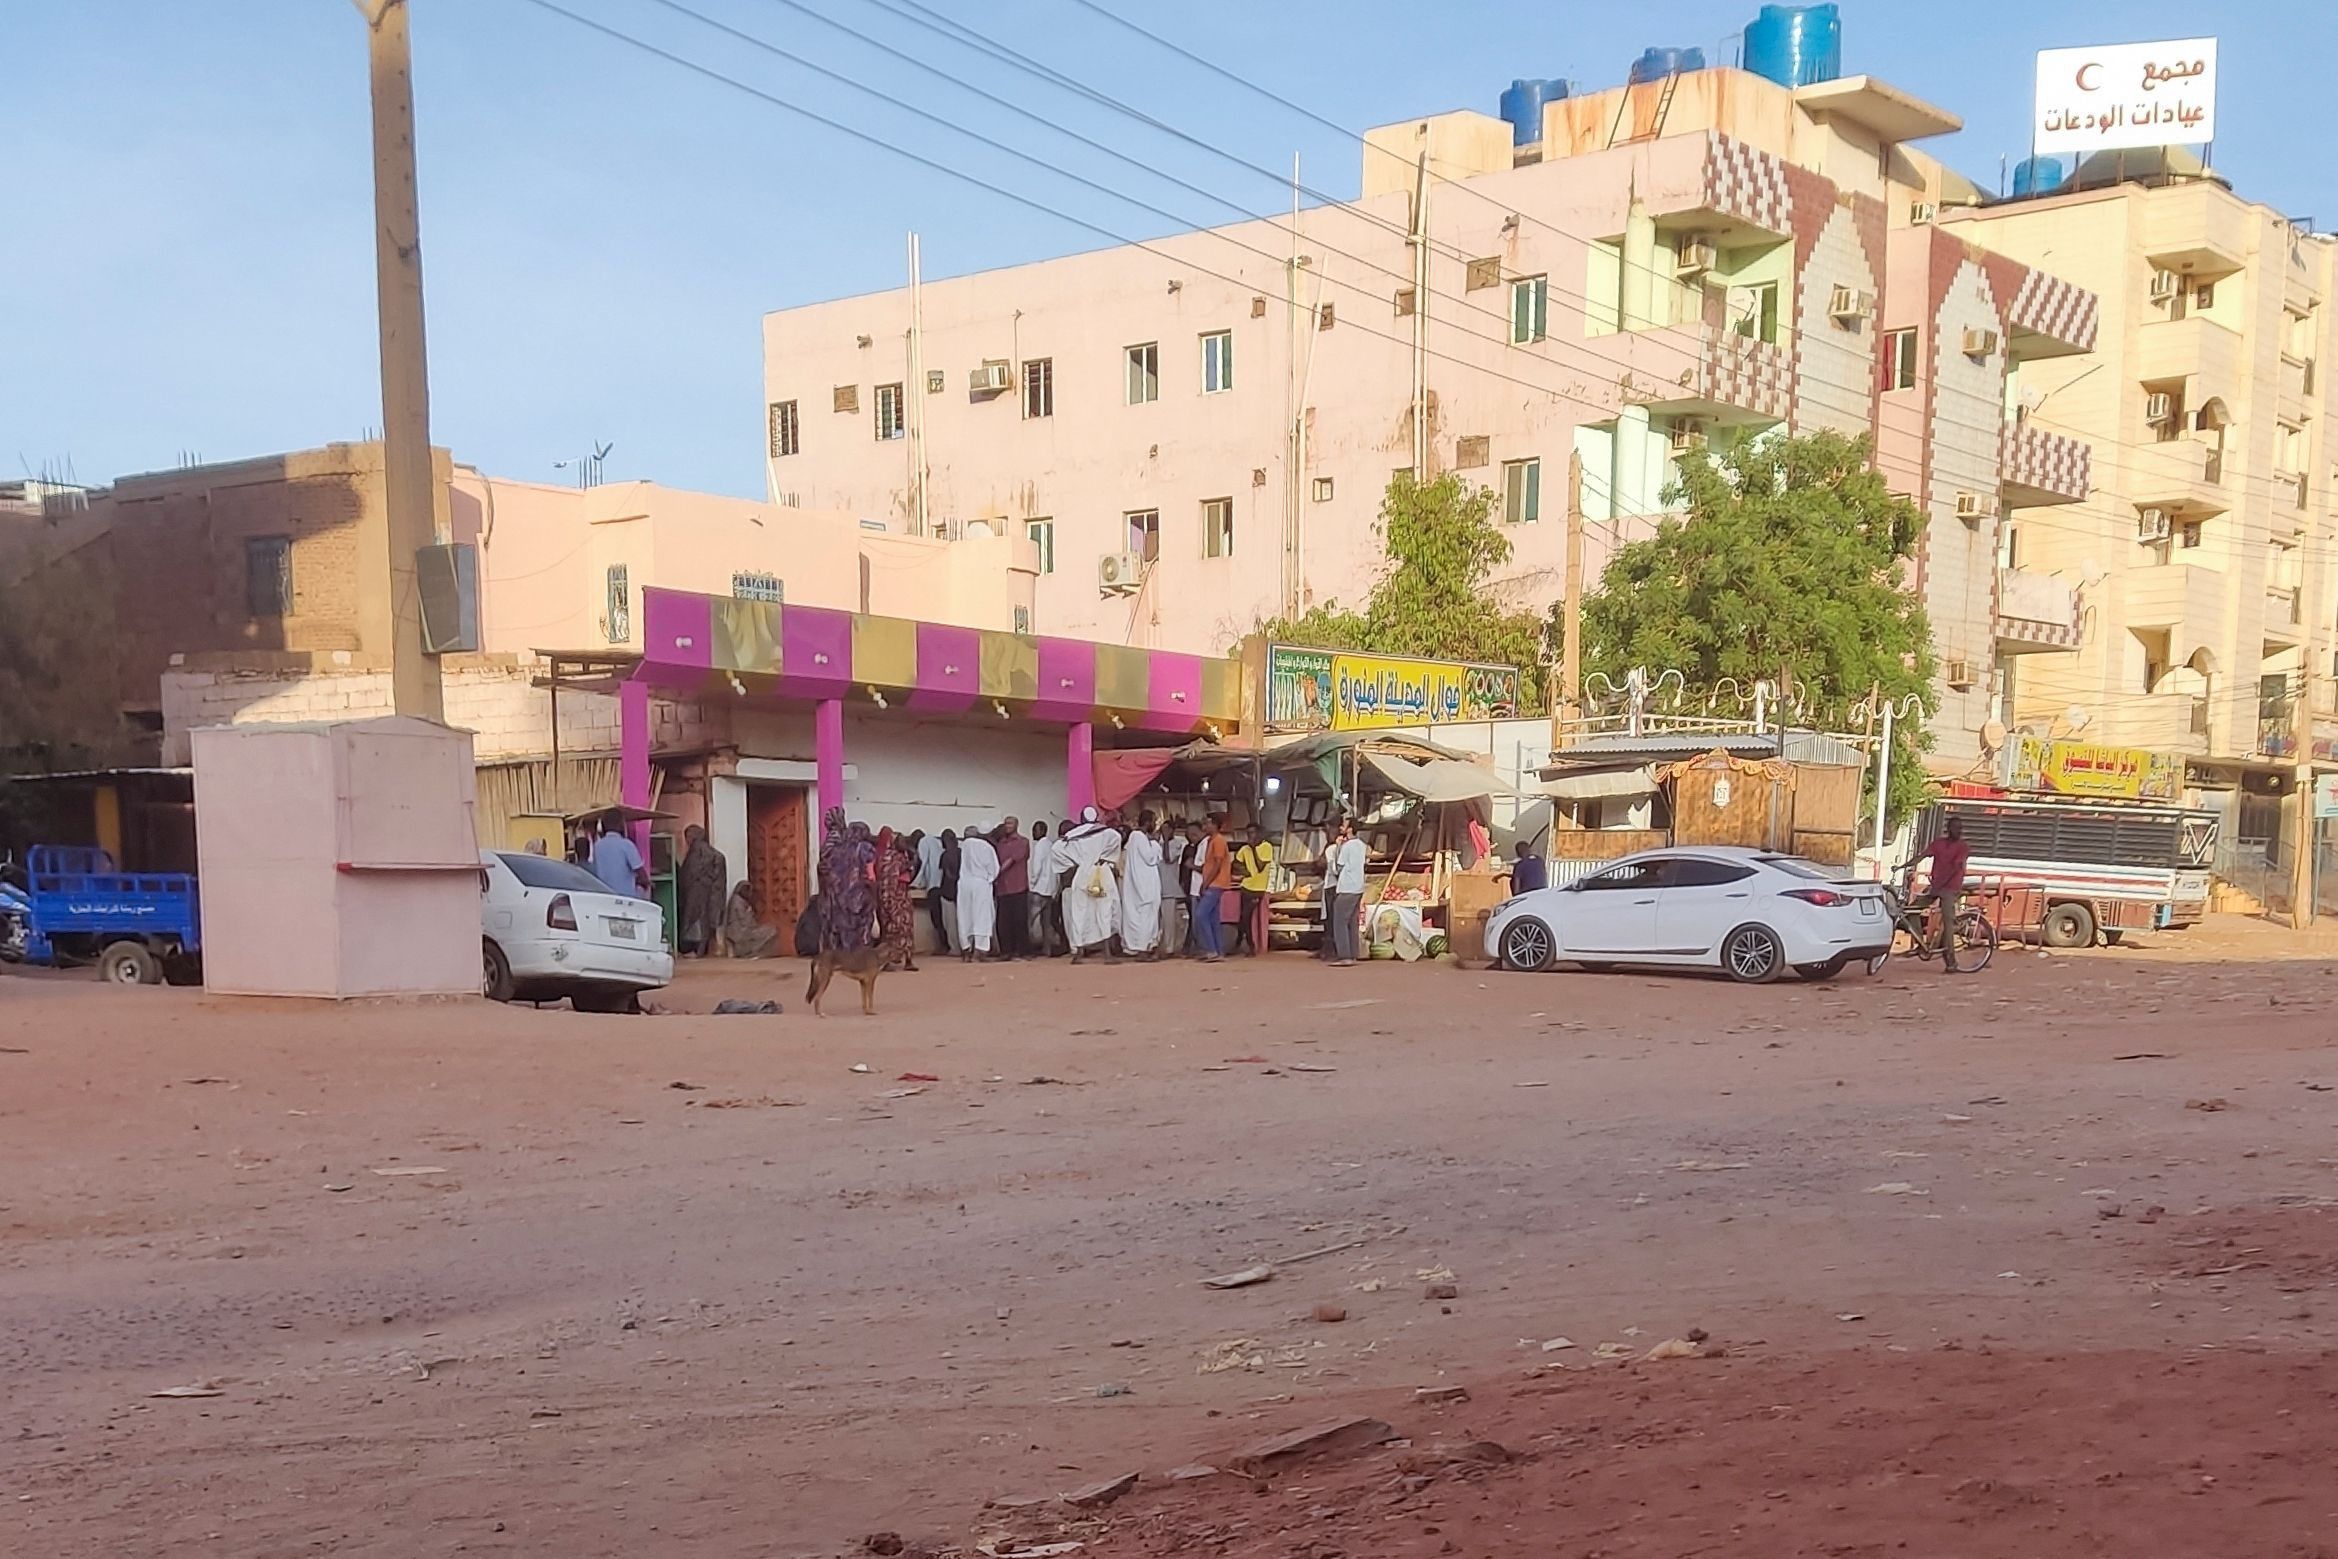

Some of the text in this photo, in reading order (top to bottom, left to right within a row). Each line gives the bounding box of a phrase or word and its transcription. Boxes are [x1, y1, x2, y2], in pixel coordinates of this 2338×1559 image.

[2141, 58, 2205, 91] مجمع
[2044, 99, 2205, 134] عيادات الودعات
[1339, 666, 1461, 724] فوال المدينة المنورة
